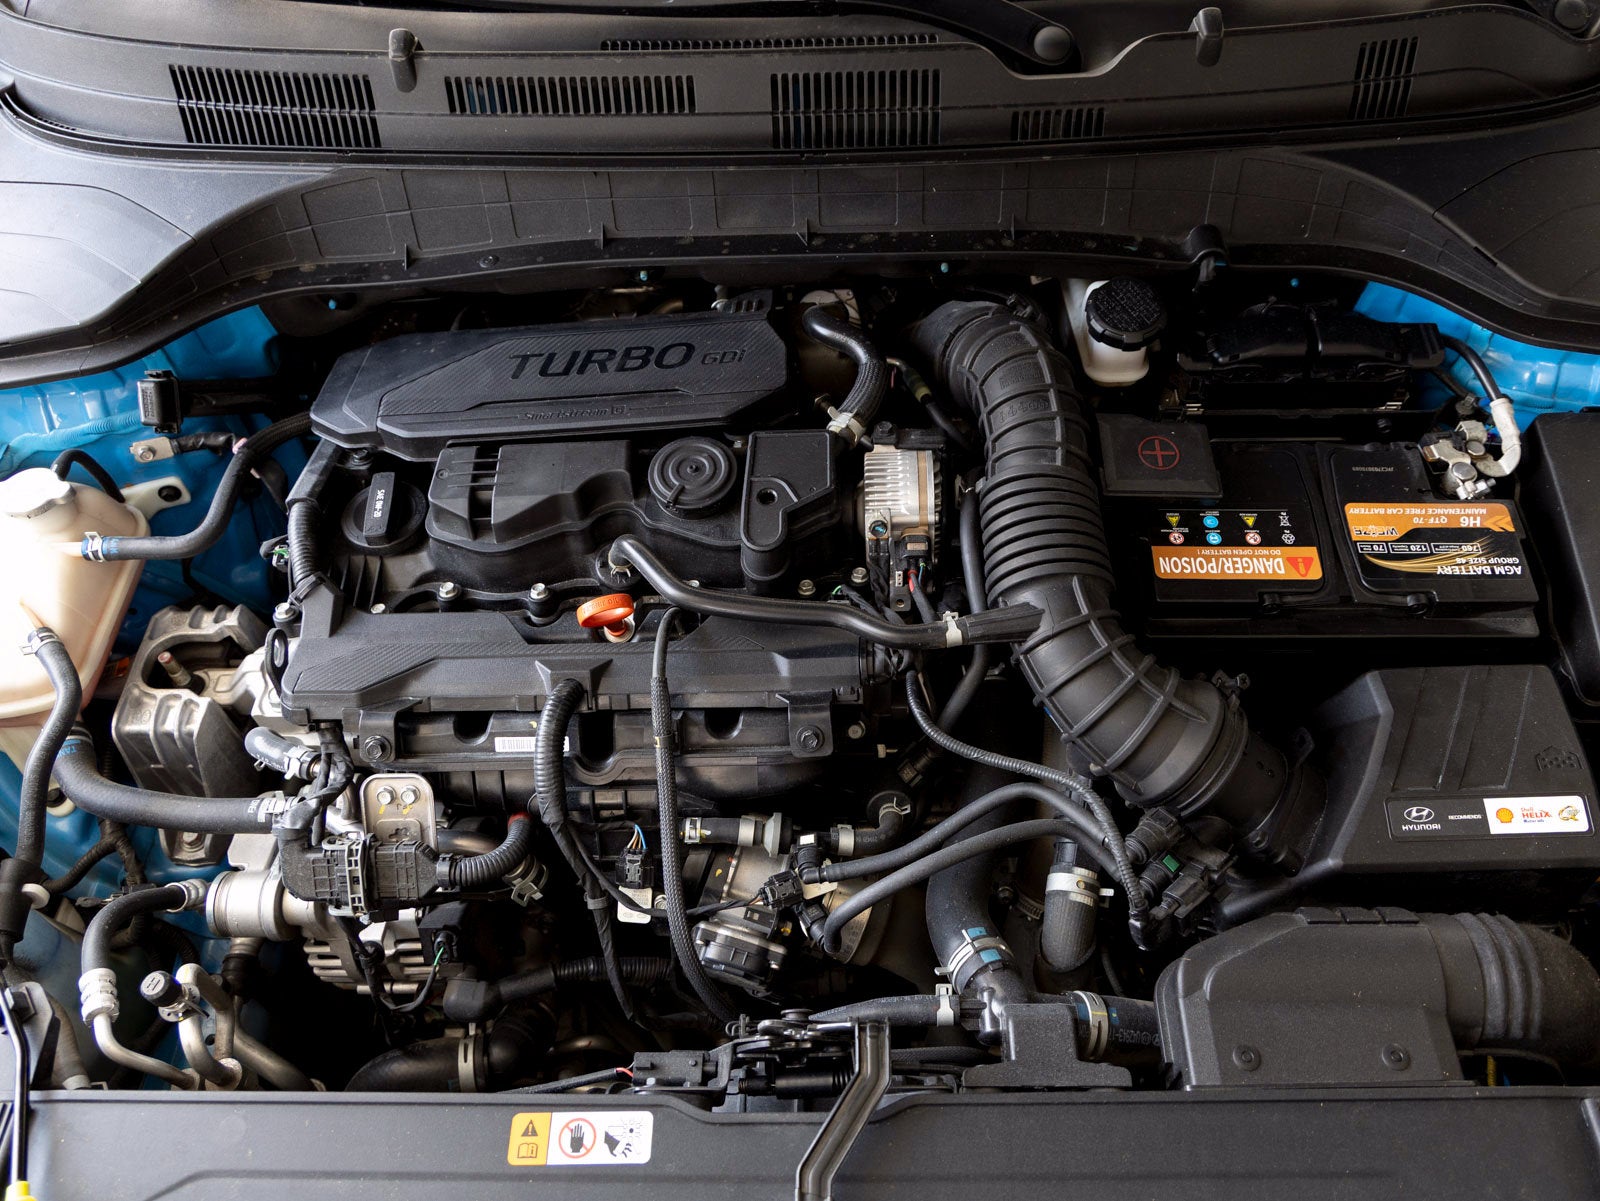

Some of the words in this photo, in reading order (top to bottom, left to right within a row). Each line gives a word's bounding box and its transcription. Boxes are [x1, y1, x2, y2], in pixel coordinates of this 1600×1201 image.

[509, 342, 696, 380] TURBO
[376, 489, 386, 500] SAE
[1348, 507, 1385, 515] BATTERY
[1386, 507, 1404, 515] CAR
[1405, 507, 1426, 515] FREE
[1427, 507, 1487, 515] MAINTENANCE
[1413, 516, 1448, 524] QTF-70
[1459, 516, 1481, 527] H6
[1373, 544, 1385, 552] 70
[1410, 544, 1427, 552] 120
[1461, 544, 1479, 552] 760
[1159, 557, 1285, 575] DANGER/POISON
[1436, 565, 1492, 575] BATTERY
[1493, 565, 1522, 575] AGM
[1521, 811, 1552, 819] HELIX
[1402, 823, 1441, 832] HYUNDAI
